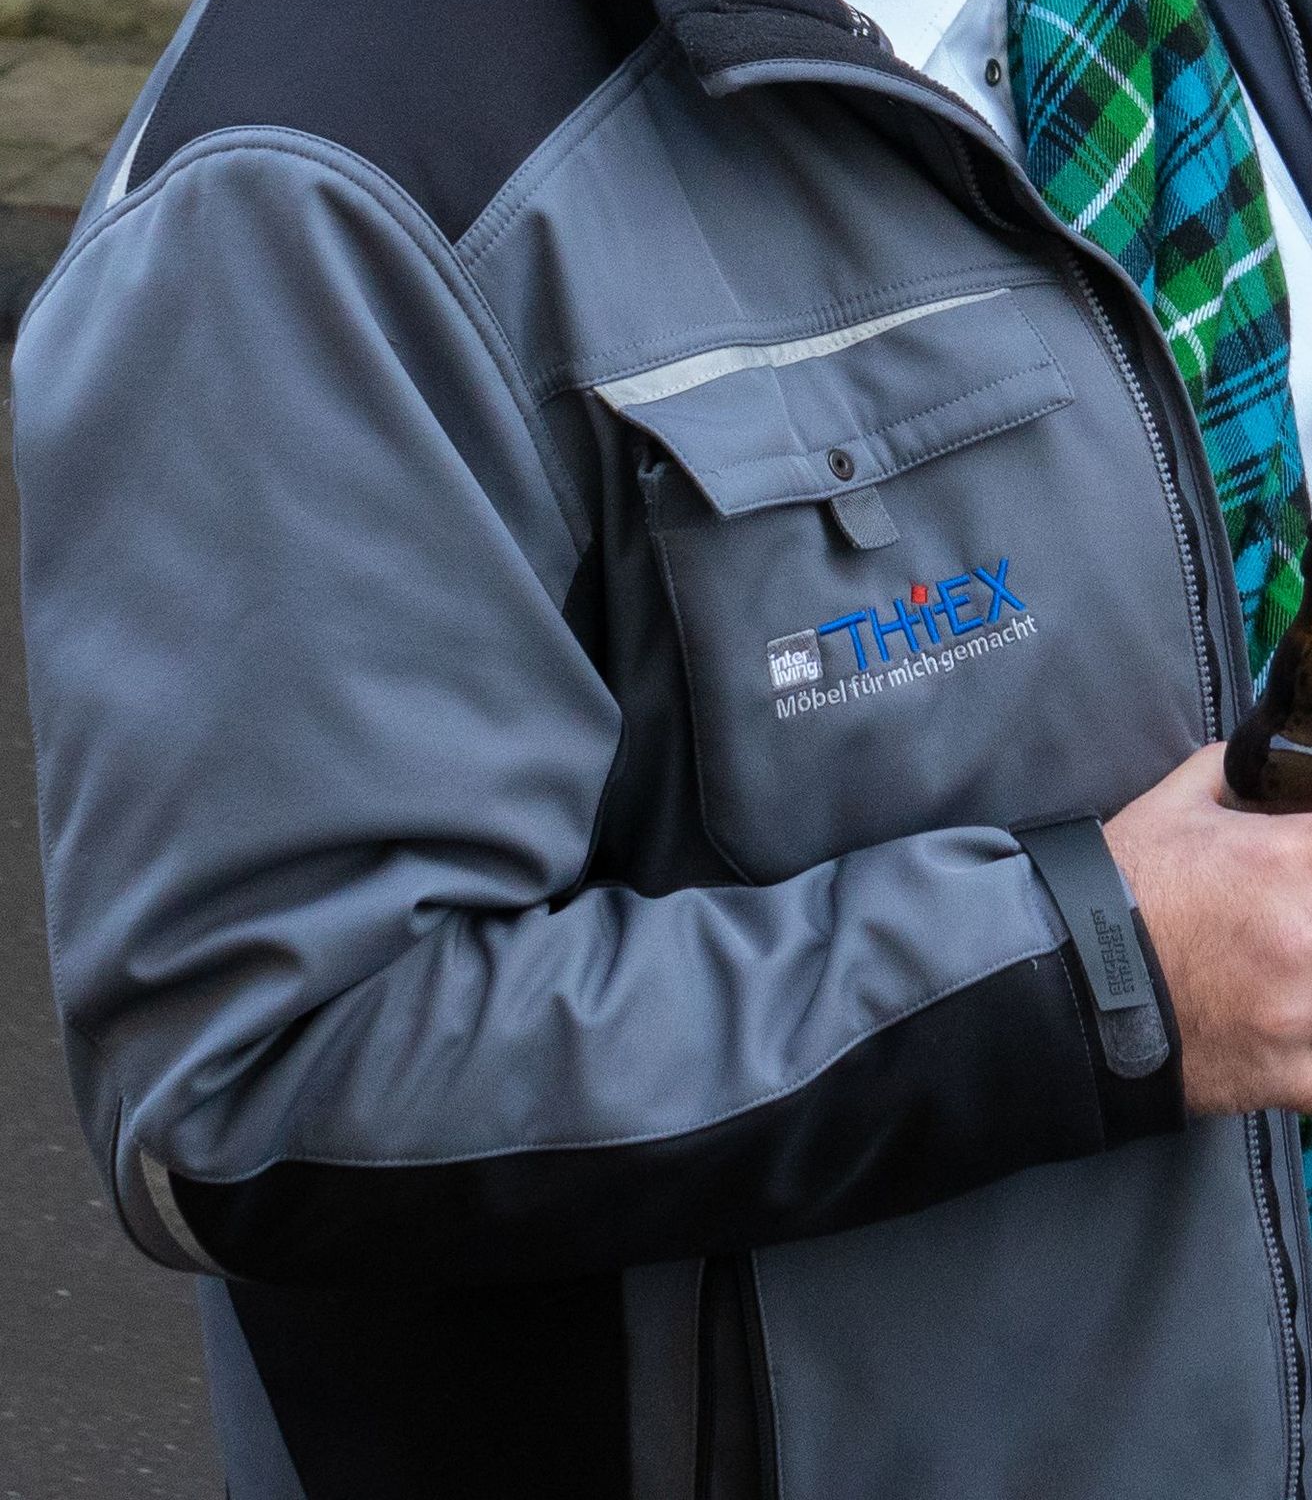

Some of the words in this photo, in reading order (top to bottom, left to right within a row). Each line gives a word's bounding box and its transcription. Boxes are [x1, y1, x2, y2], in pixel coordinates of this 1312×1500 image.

[770, 650, 809, 670] inter
[776, 679, 847, 719] Möbel
[849, 672, 884, 699] für
[888, 653, 939, 688] mich
[940, 614, 1039, 672] gemacht
[773, 661, 818, 686] living
